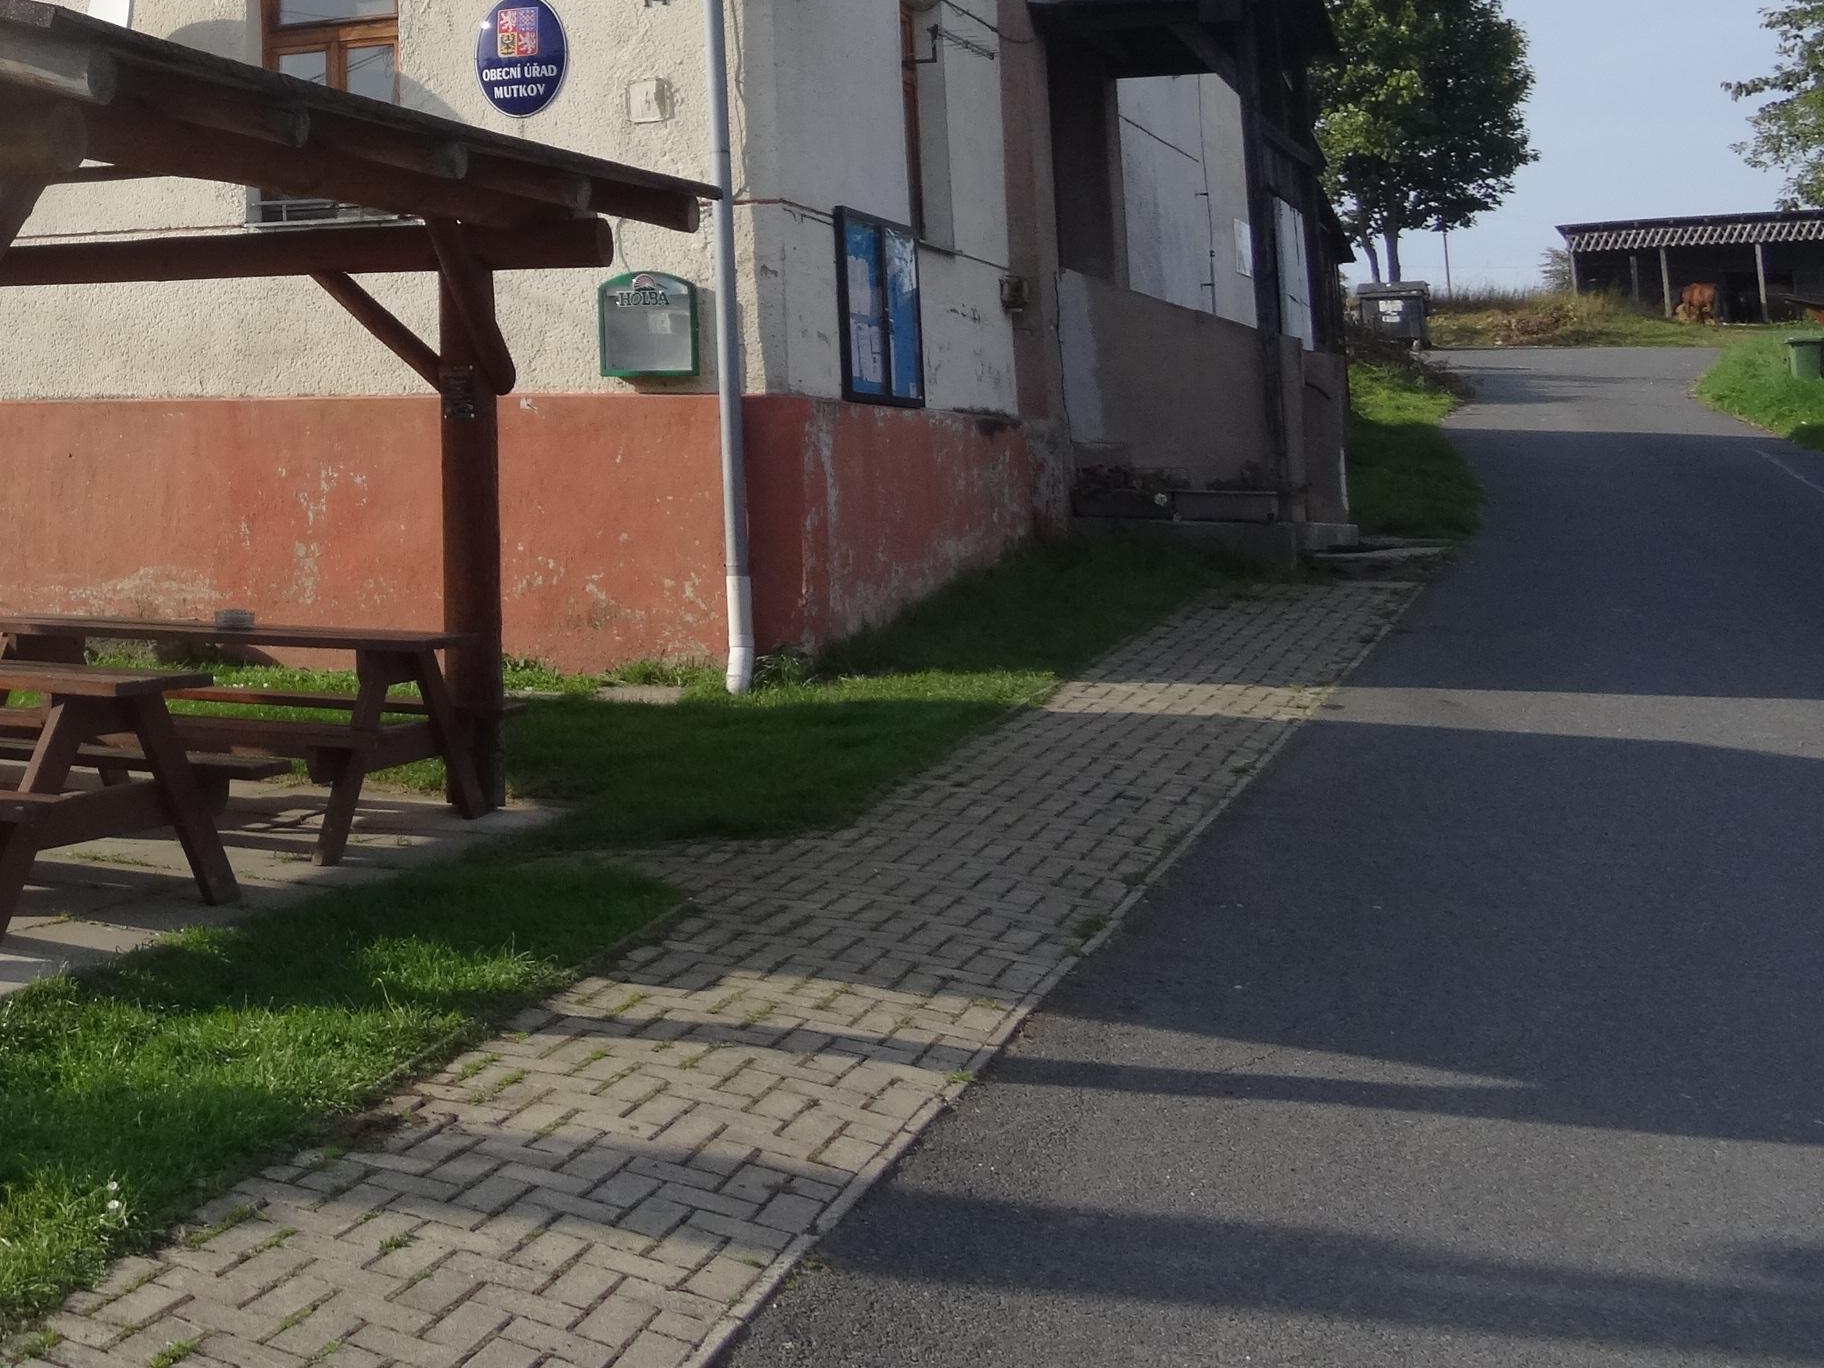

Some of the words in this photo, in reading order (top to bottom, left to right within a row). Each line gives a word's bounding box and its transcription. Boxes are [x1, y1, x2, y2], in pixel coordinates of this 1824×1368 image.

[482, 64, 522, 81] OBECNÍ
[523, 62, 557, 77] ÚŘAD
[494, 83, 546, 99] MUTKOV
[618, 290, 670, 307] HOLBA
